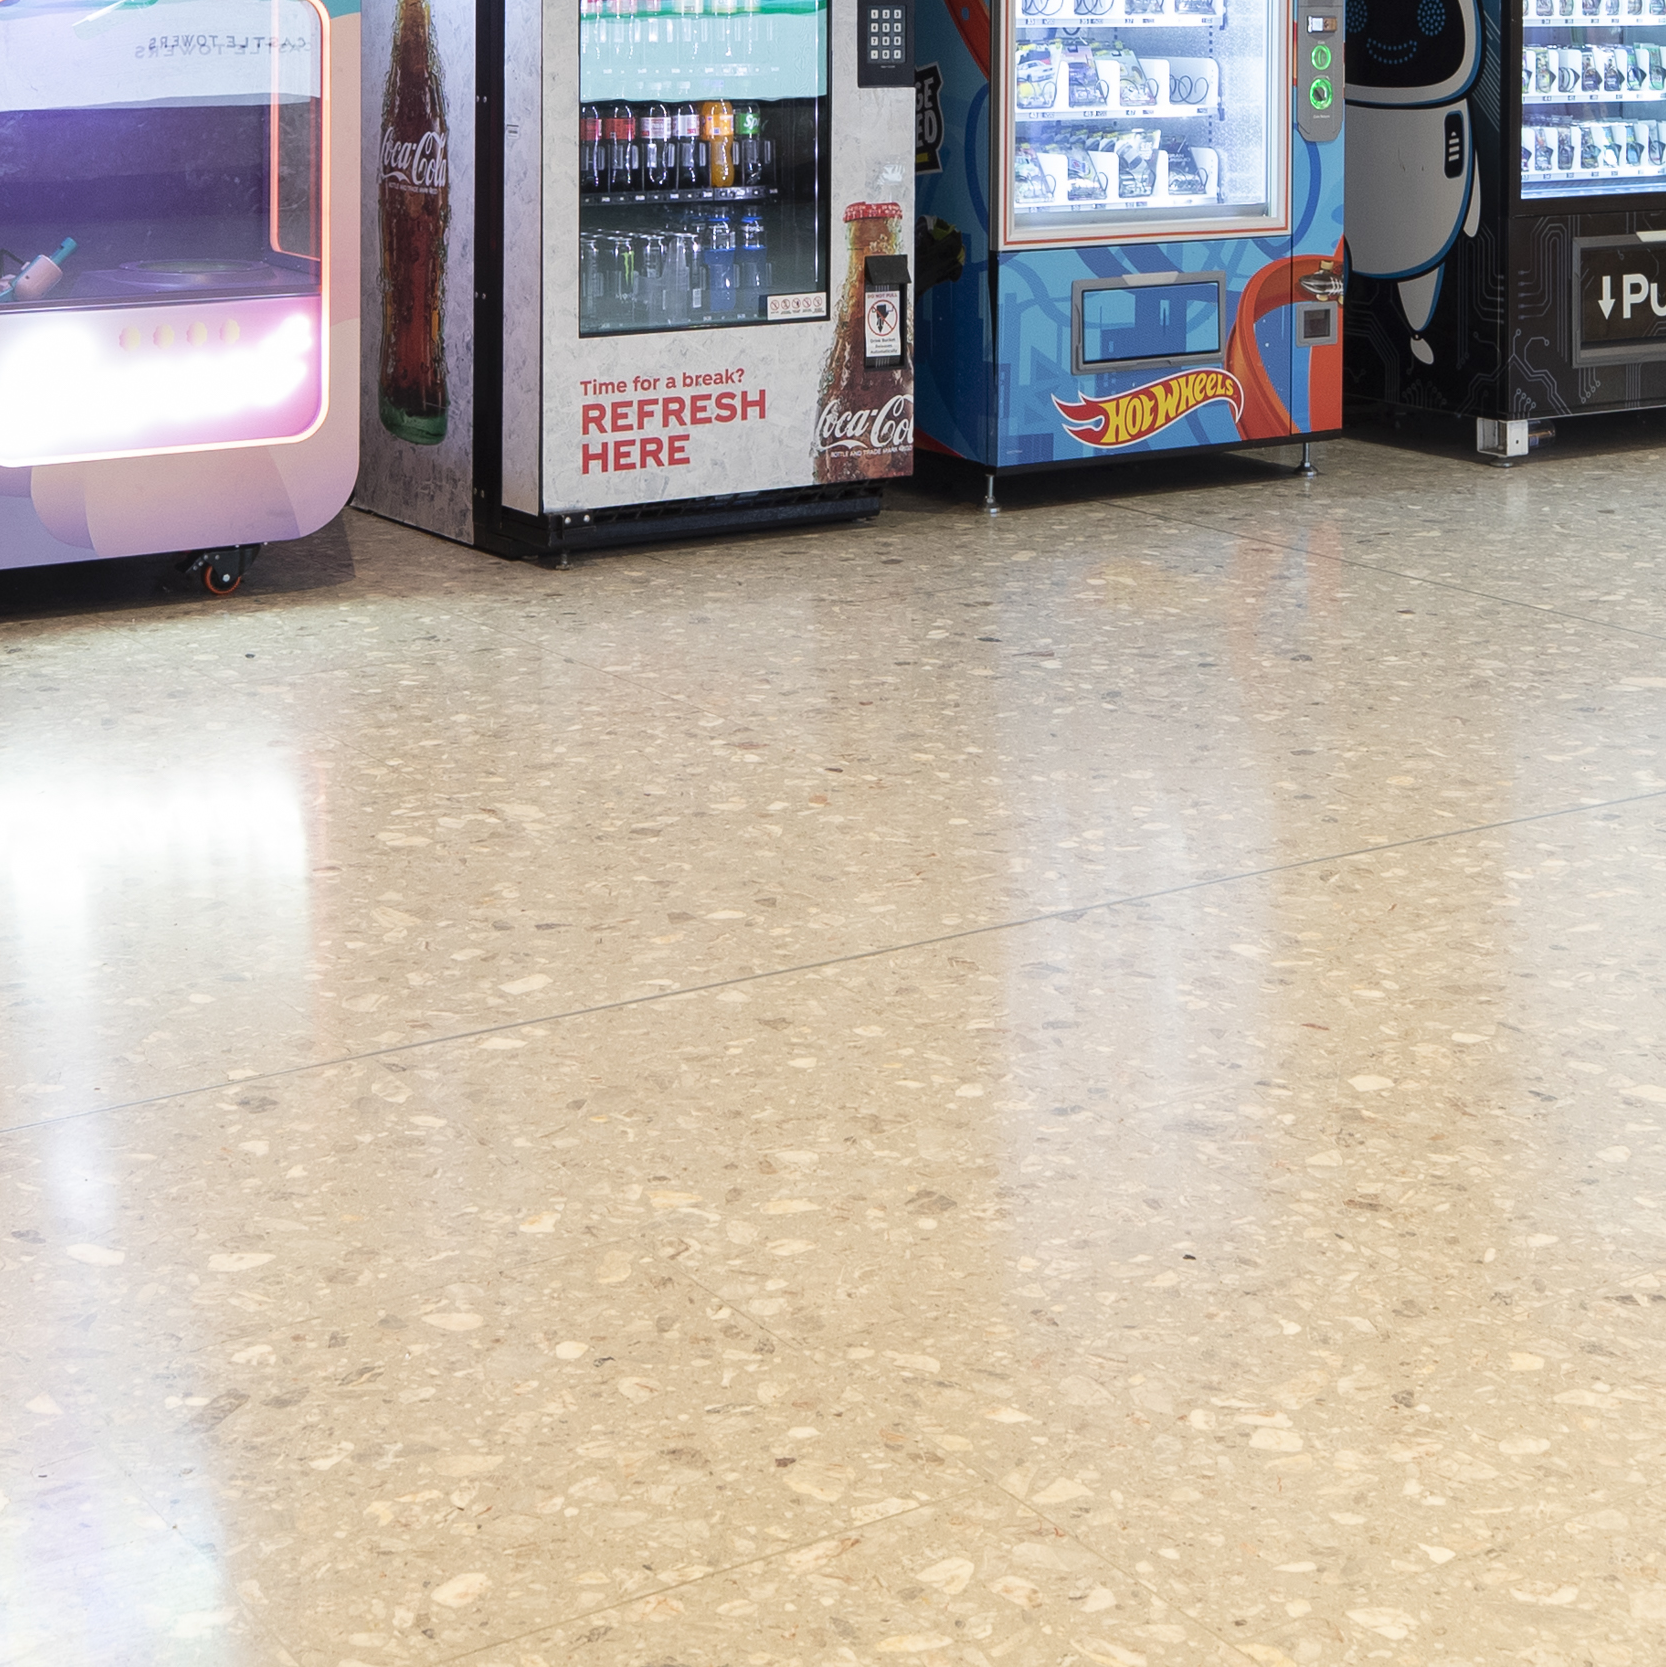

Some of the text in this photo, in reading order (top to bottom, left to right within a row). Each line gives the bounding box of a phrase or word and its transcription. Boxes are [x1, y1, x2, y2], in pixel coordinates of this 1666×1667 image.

[381, 126, 447, 187] Coca-Cola
[580, 369, 745, 396] Time for a break?
[581, 389, 767, 436] REFRESH
[581, 434, 691, 475] HERE
